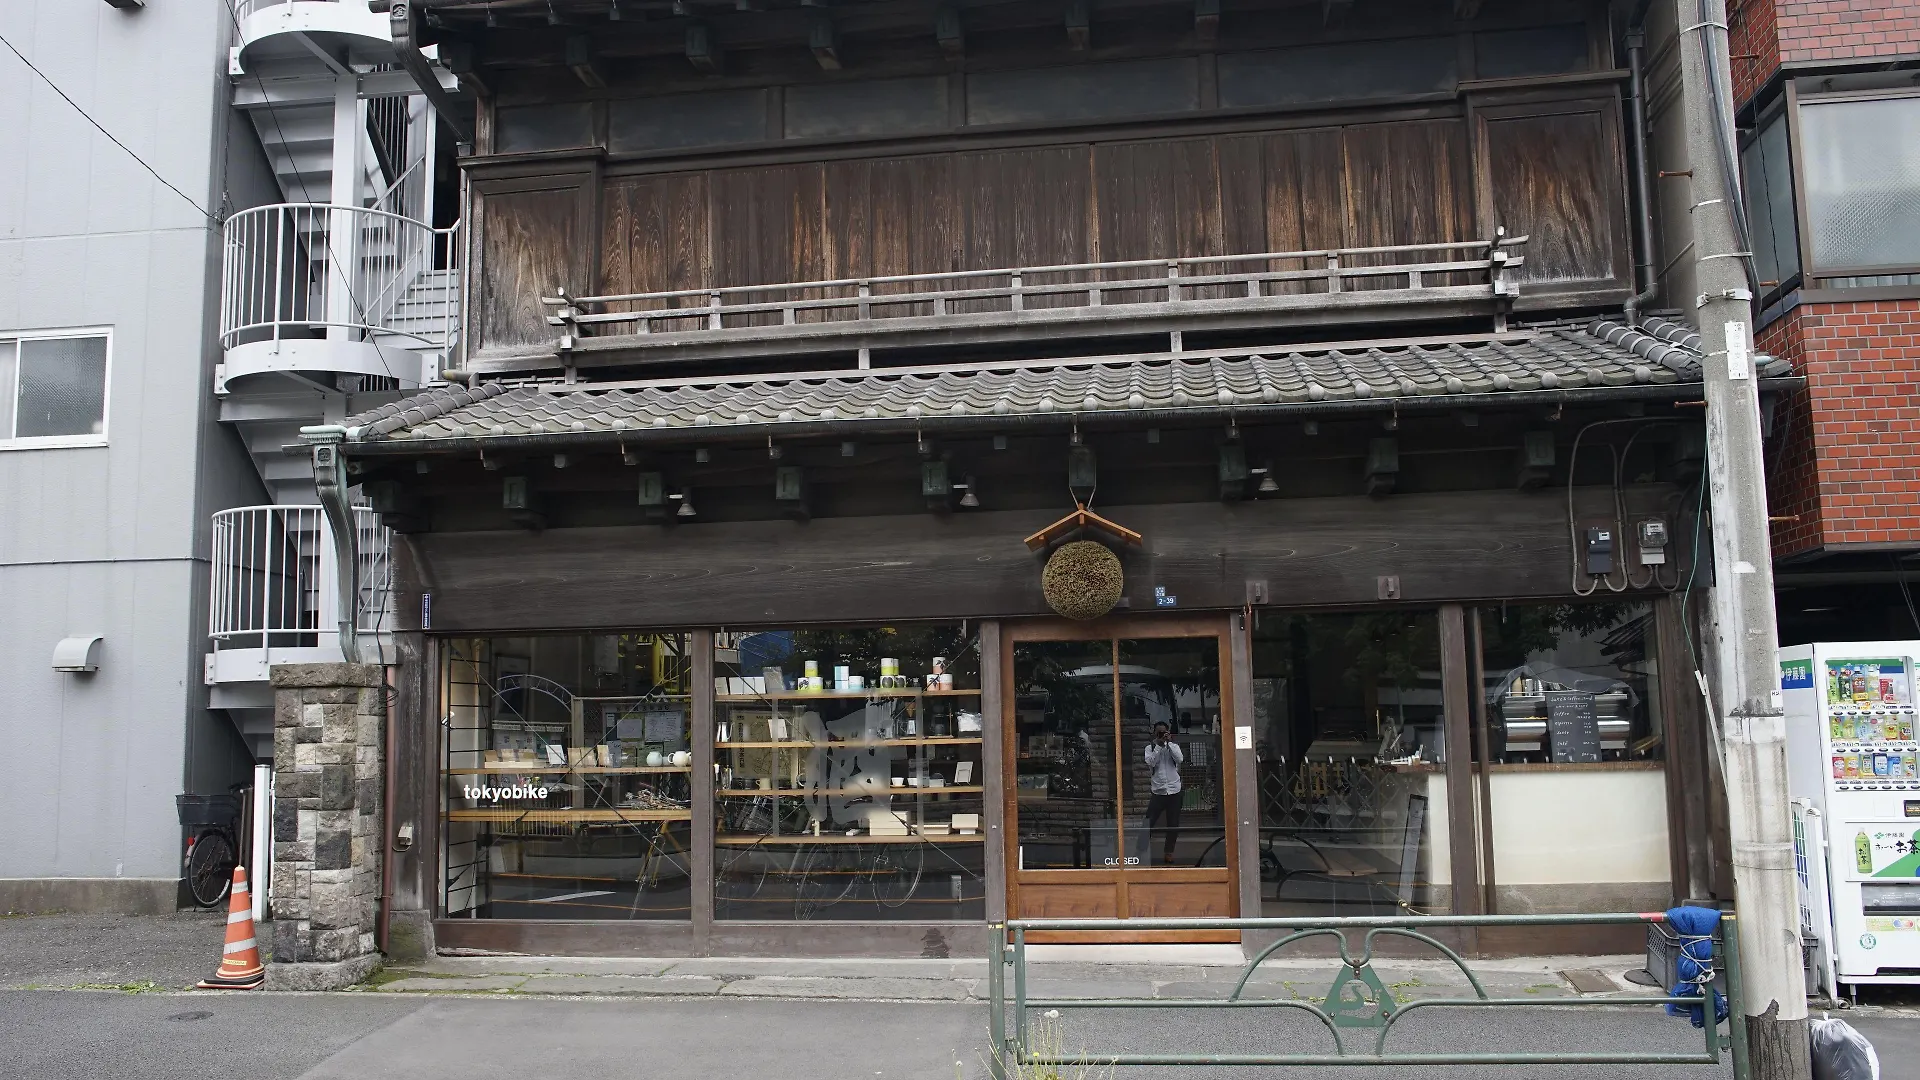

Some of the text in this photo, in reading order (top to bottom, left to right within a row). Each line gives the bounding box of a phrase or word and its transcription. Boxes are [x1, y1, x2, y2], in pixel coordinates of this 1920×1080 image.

[1158, 597, 1174, 605] 2-39
[1785, 666, 1806, 682] 伊藤園
[463, 784, 548, 803] tokyobike
[1104, 856, 1140, 866] CLOSED
